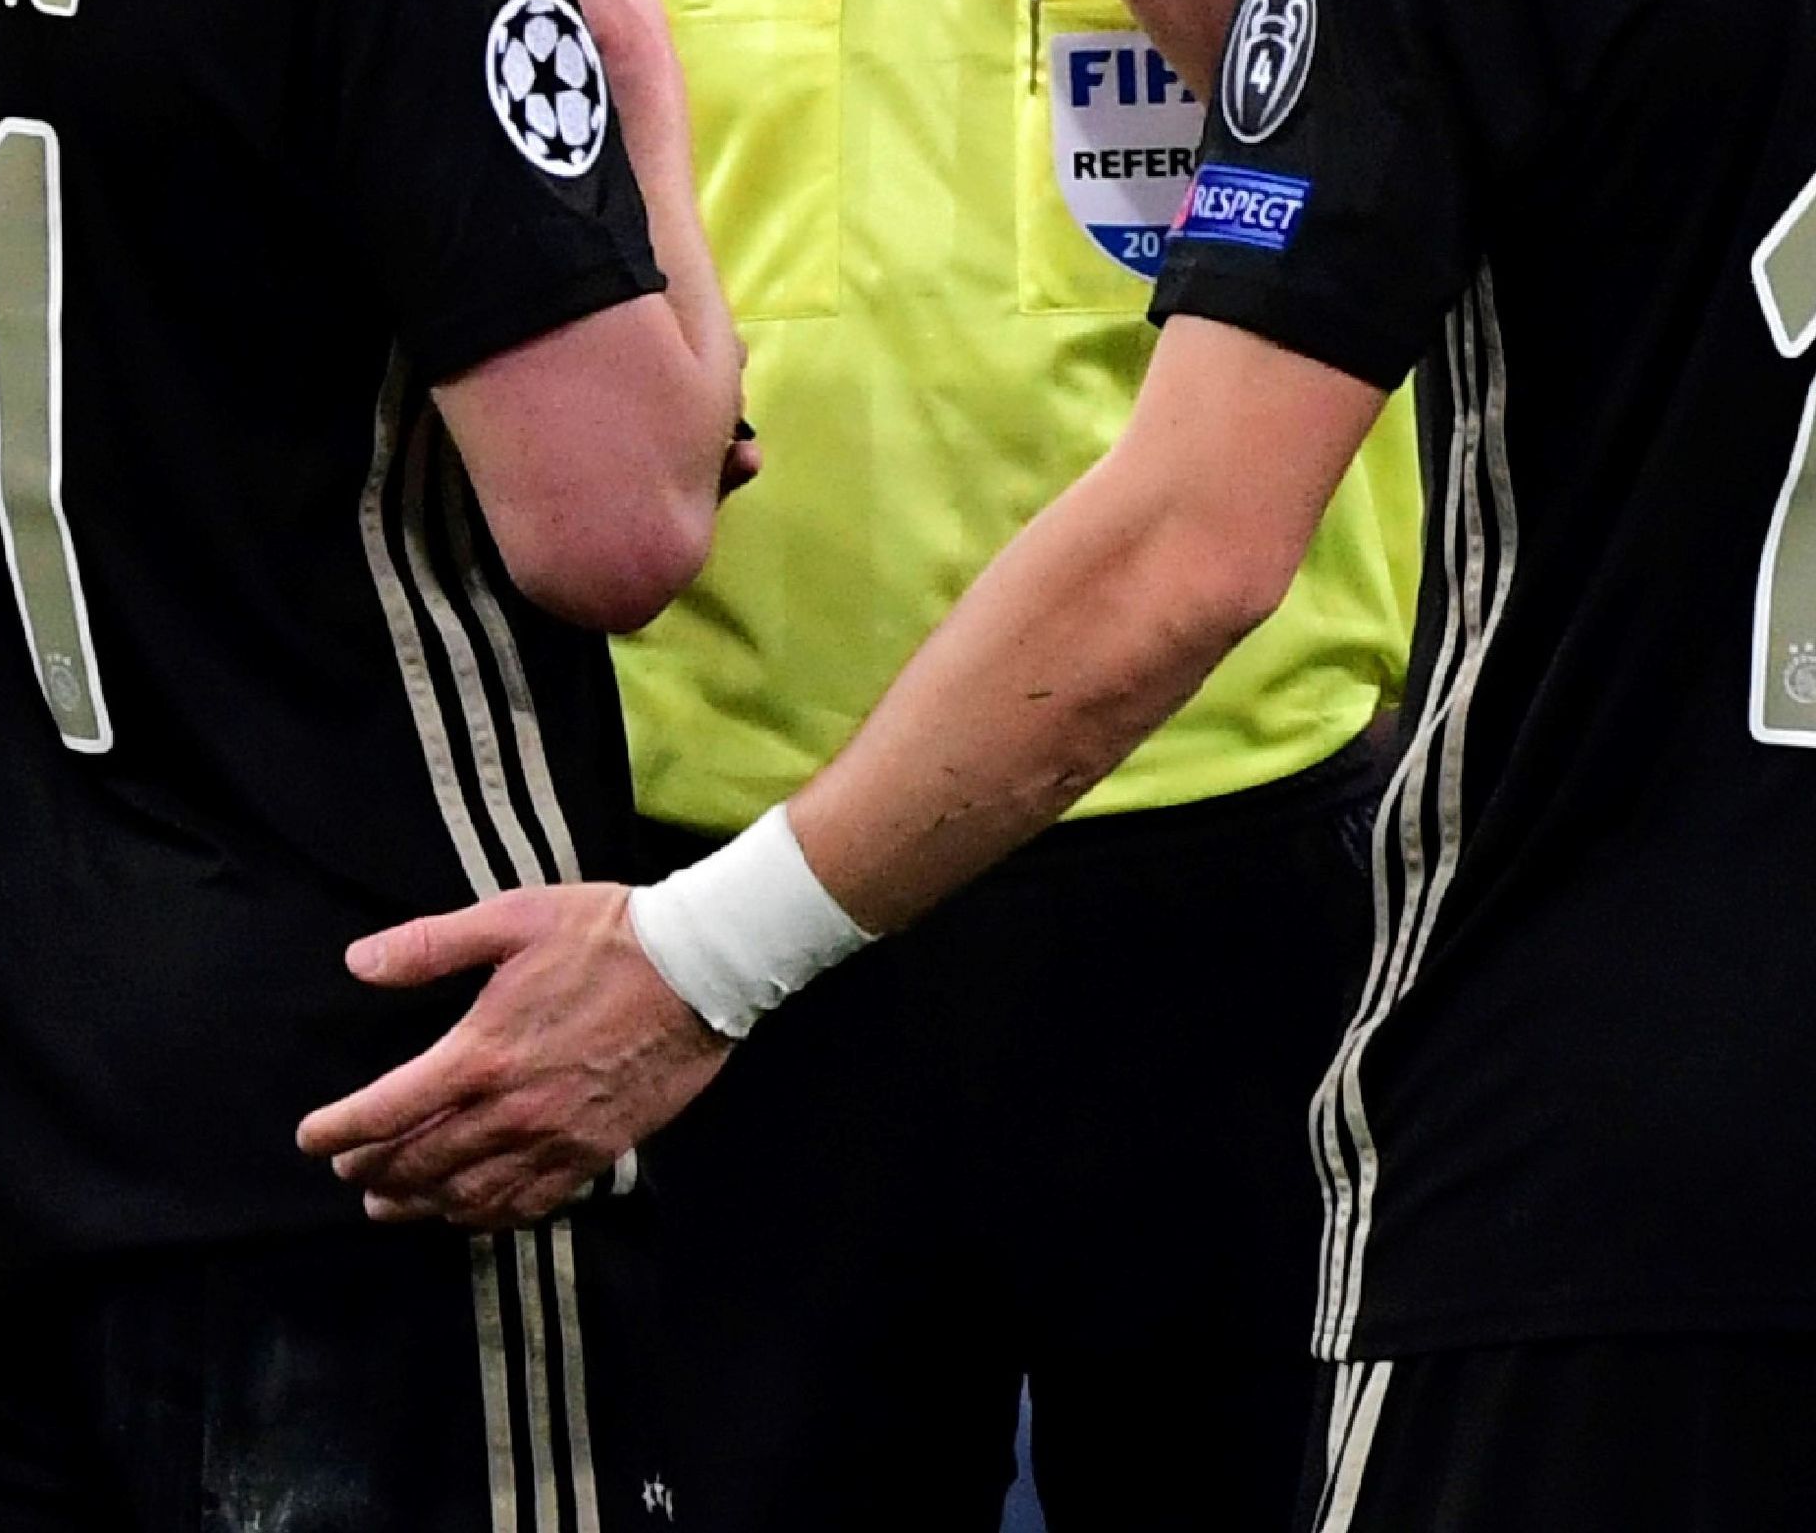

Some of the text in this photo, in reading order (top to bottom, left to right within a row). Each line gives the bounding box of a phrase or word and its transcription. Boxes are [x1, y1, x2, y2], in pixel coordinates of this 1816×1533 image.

[1250, 48, 1273, 95] 4
[1072, 147, 1198, 180] REFER
[1191, 184, 1304, 230] RESPECT
[1122, 231, 1161, 259] 20
